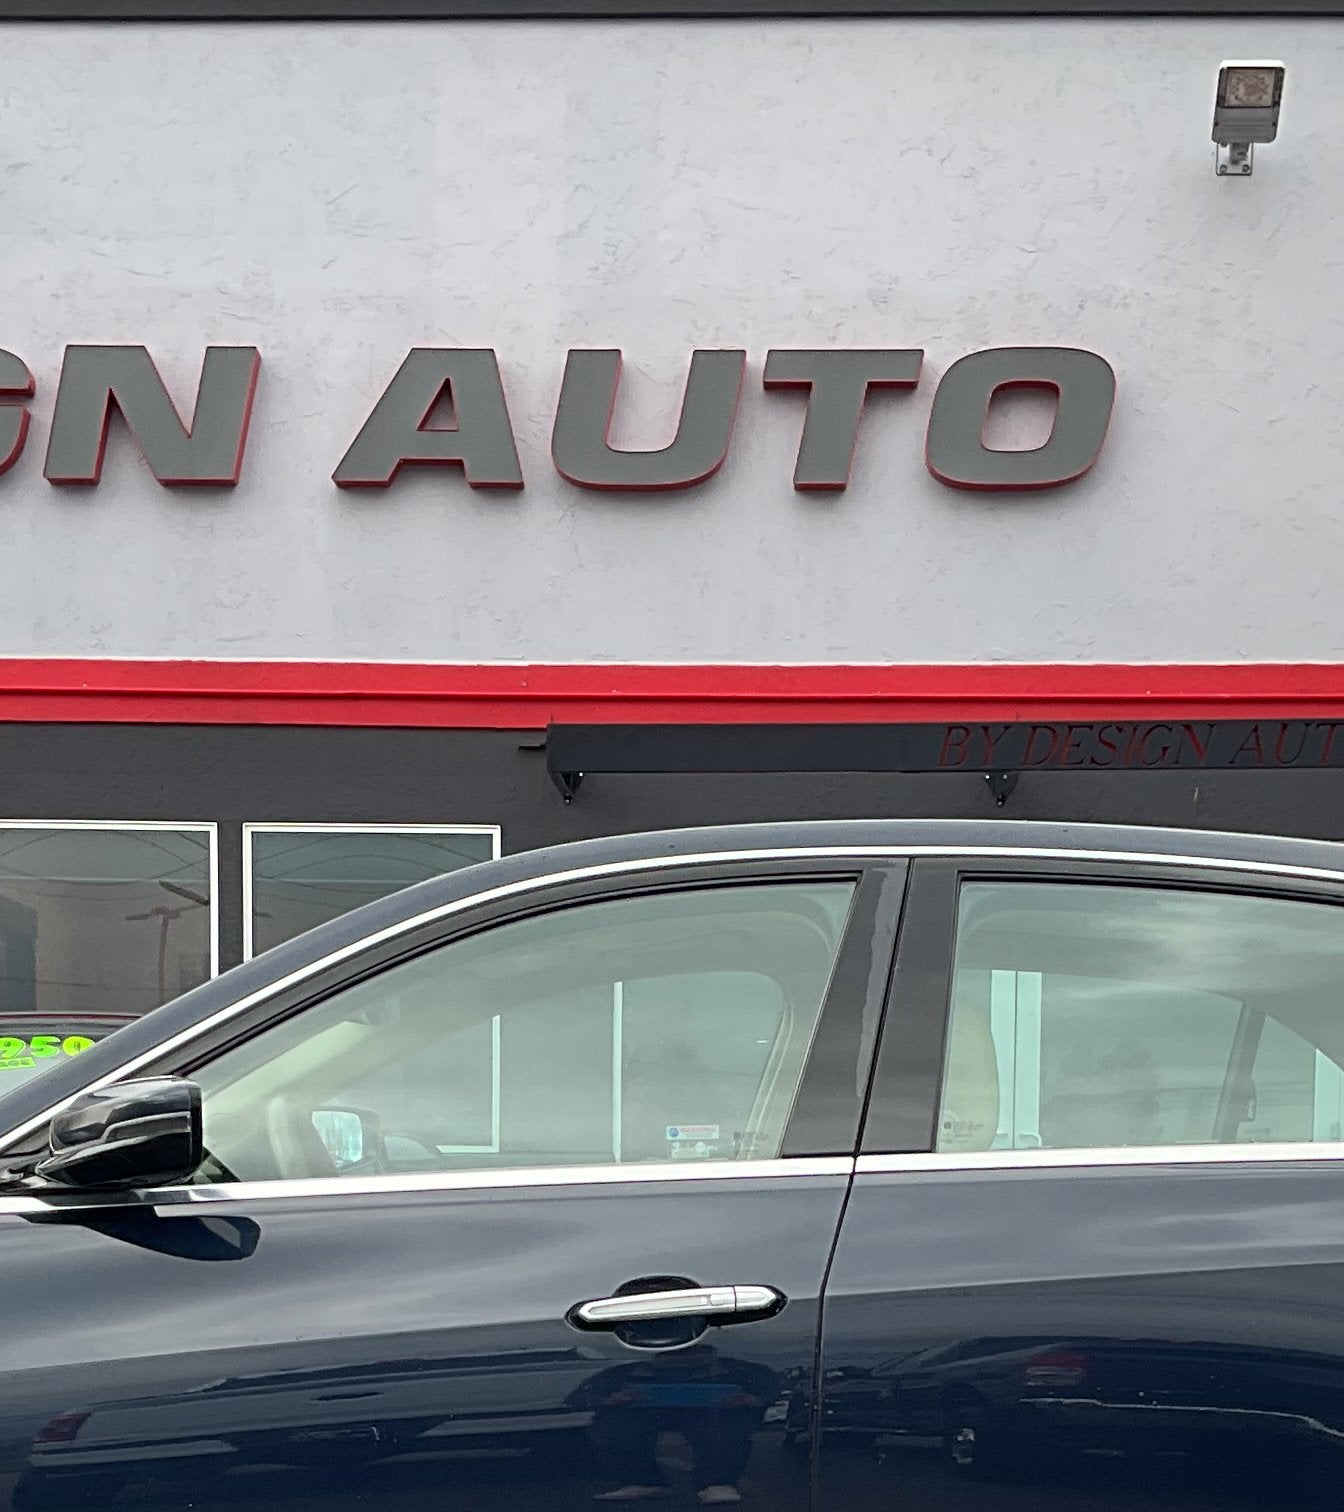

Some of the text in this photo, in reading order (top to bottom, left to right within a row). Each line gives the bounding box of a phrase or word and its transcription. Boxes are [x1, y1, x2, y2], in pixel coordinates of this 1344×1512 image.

[332, 347, 1117, 492] AUTO
[938, 724, 1013, 768] BY
[1021, 723, 1218, 768] DESIGN
